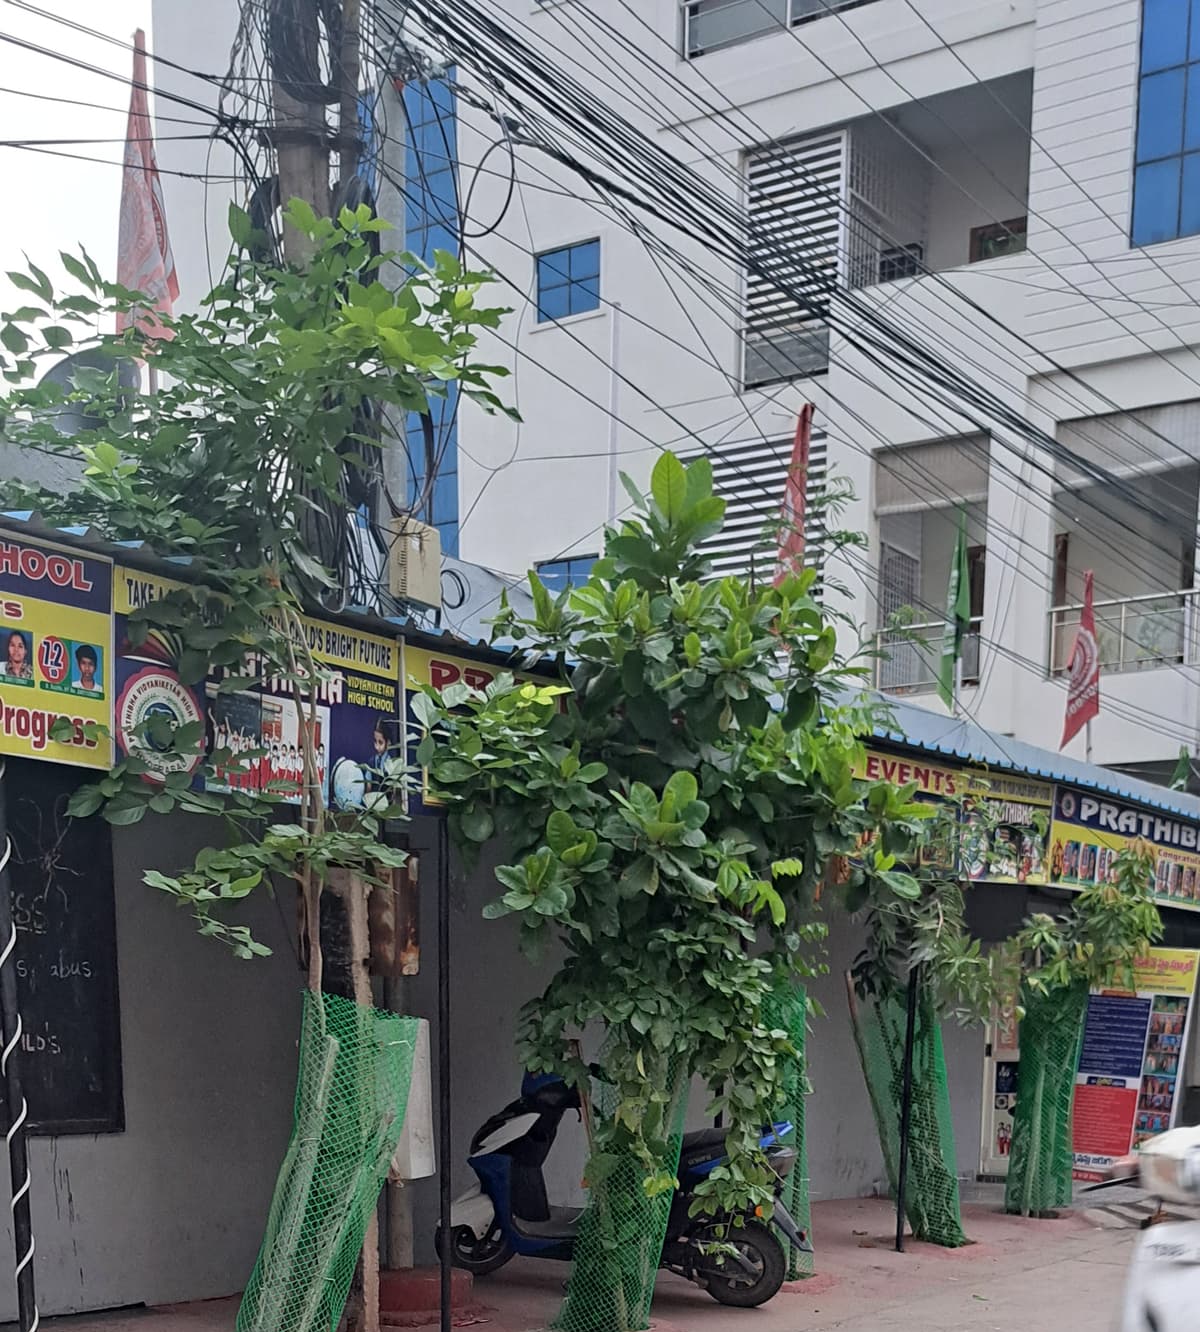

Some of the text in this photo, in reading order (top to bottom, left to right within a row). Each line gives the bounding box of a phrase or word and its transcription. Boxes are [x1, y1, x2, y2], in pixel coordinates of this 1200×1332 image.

[325, 629, 357, 662] BRIGHT
[359, 639, 391, 671] FUTURE
[367, 695, 395, 713] SCHOOL
[866, 756, 956, 796] EVENTS
[1080, 798, 1200, 851] PRATHIB
